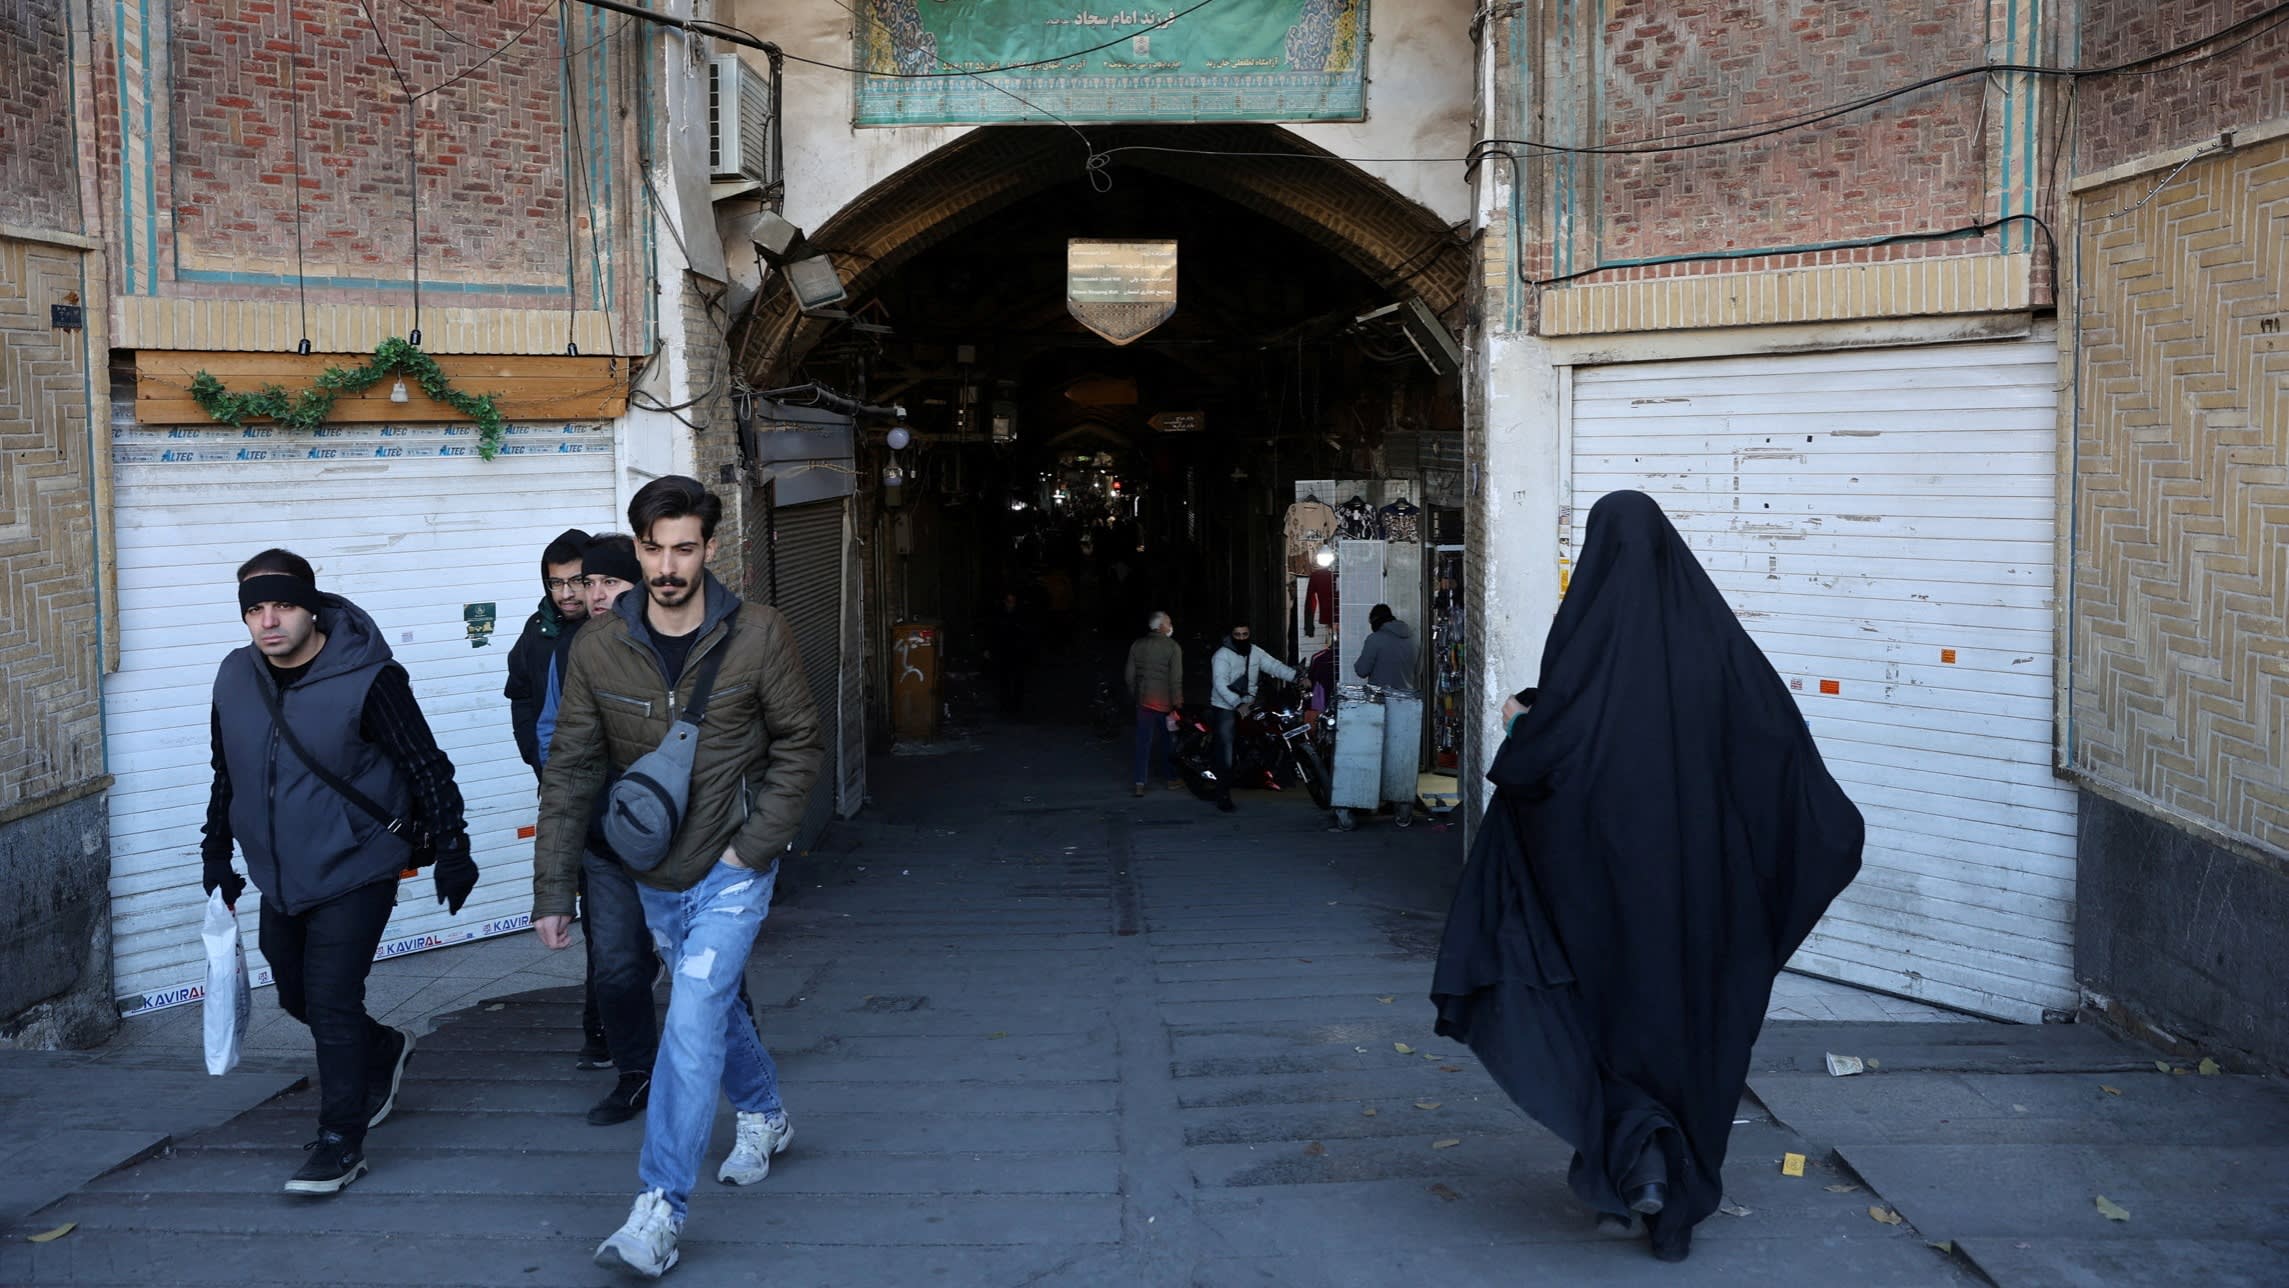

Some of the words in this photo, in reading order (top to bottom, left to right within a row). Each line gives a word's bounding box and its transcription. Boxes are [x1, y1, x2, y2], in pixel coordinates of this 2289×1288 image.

[1074, 10, 1109, 29] سجاد
[1111, 10, 1137, 29] امام
[168, 425, 200, 438] ALTEC
[243, 425, 273, 438] ALTEC
[313, 425, 342, 437] ALTEC
[380, 425, 408, 437] ALTEC
[444, 424, 470, 436] ALTEC
[504, 424, 530, 435] ALTEC
[562, 423, 587, 434] ALTEC
[161, 449, 194, 462] ALTEC
[236, 448, 267, 461] ALTEC
[308, 447, 337, 459] ALTEC
[375, 445, 403, 457] ALTEC
[439, 445, 465, 456] ALTEC
[500, 444, 525, 455] ALTEC
[558, 442, 583, 453] ALTEC
[494, 915, 533, 932] KAVIR
[387, 935, 443, 955] KAVIRAL
